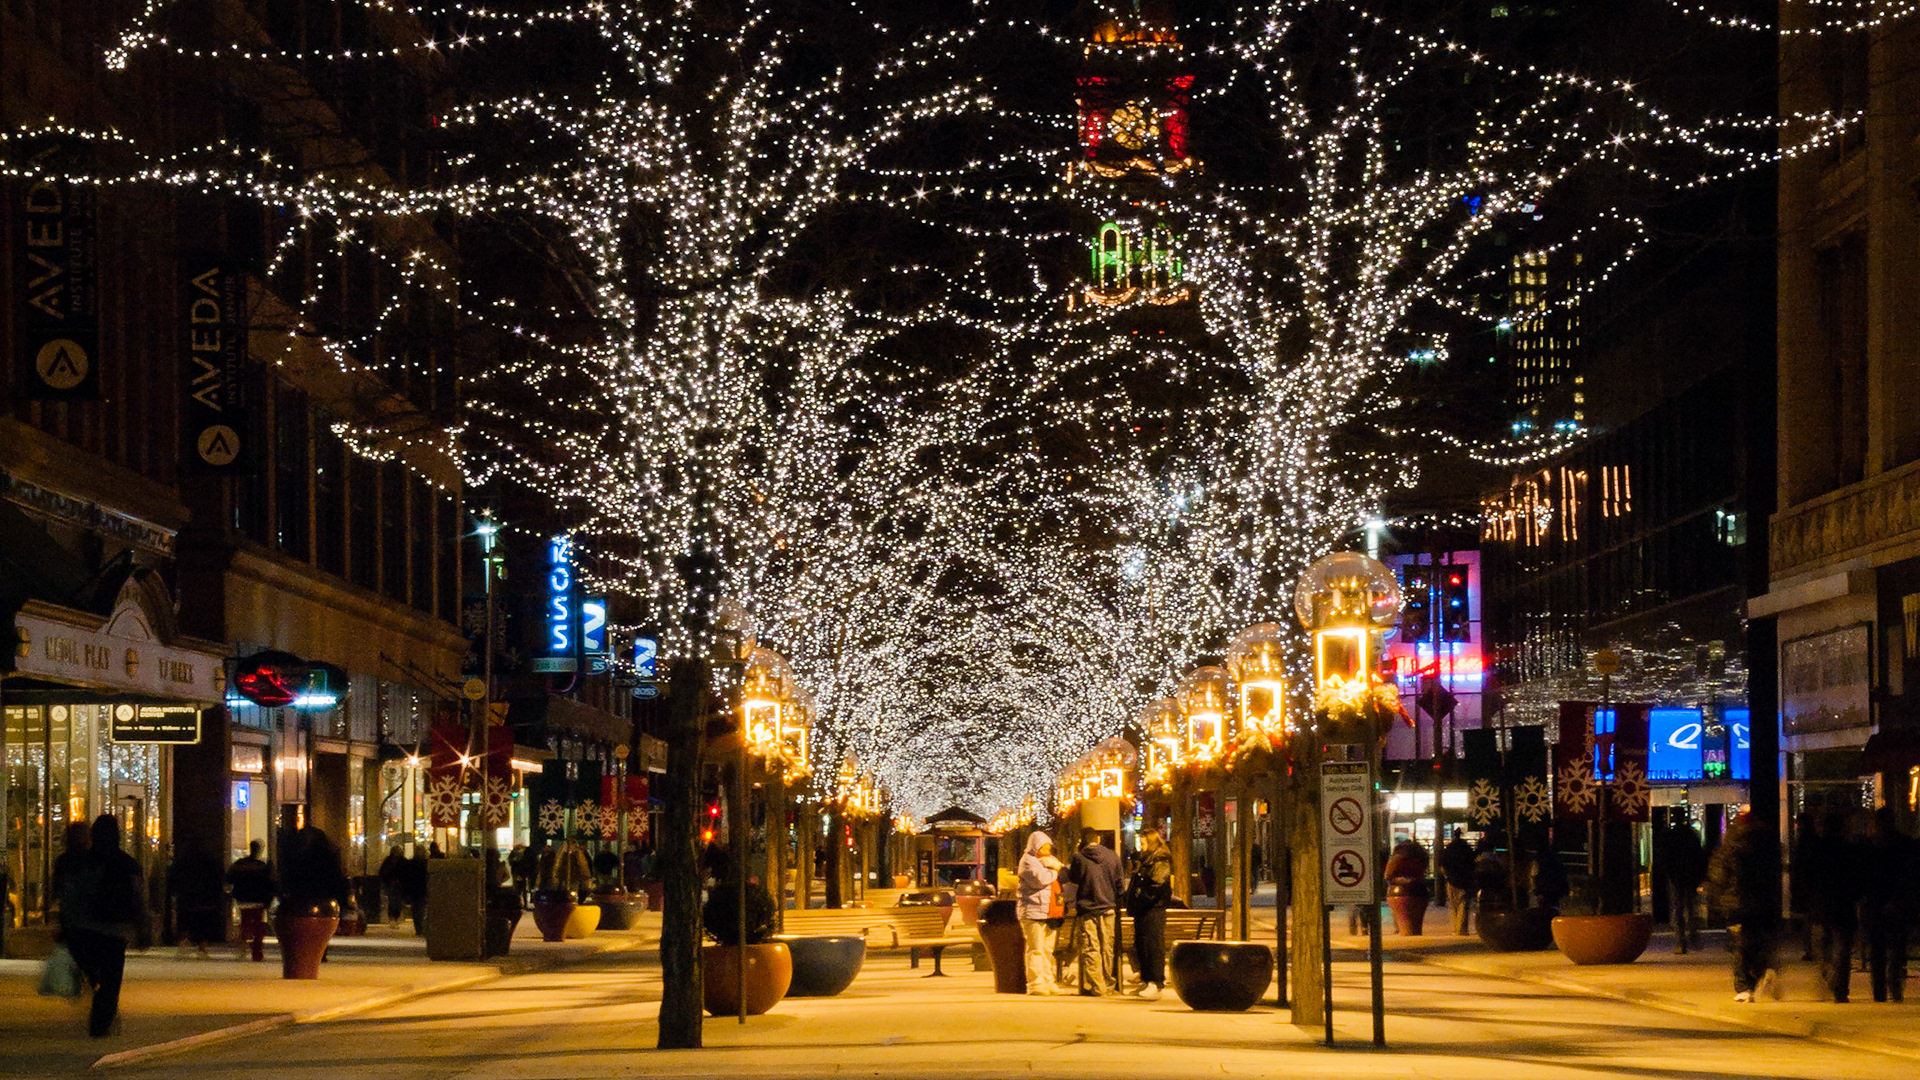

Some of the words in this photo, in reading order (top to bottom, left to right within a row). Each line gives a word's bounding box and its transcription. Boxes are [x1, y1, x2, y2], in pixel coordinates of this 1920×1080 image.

[26, 144, 65, 319] AVEDA
[190, 267, 223, 412] AVEDA
[551, 537, 569, 650] ROSS
[634, 687, 656, 696] ROSS
